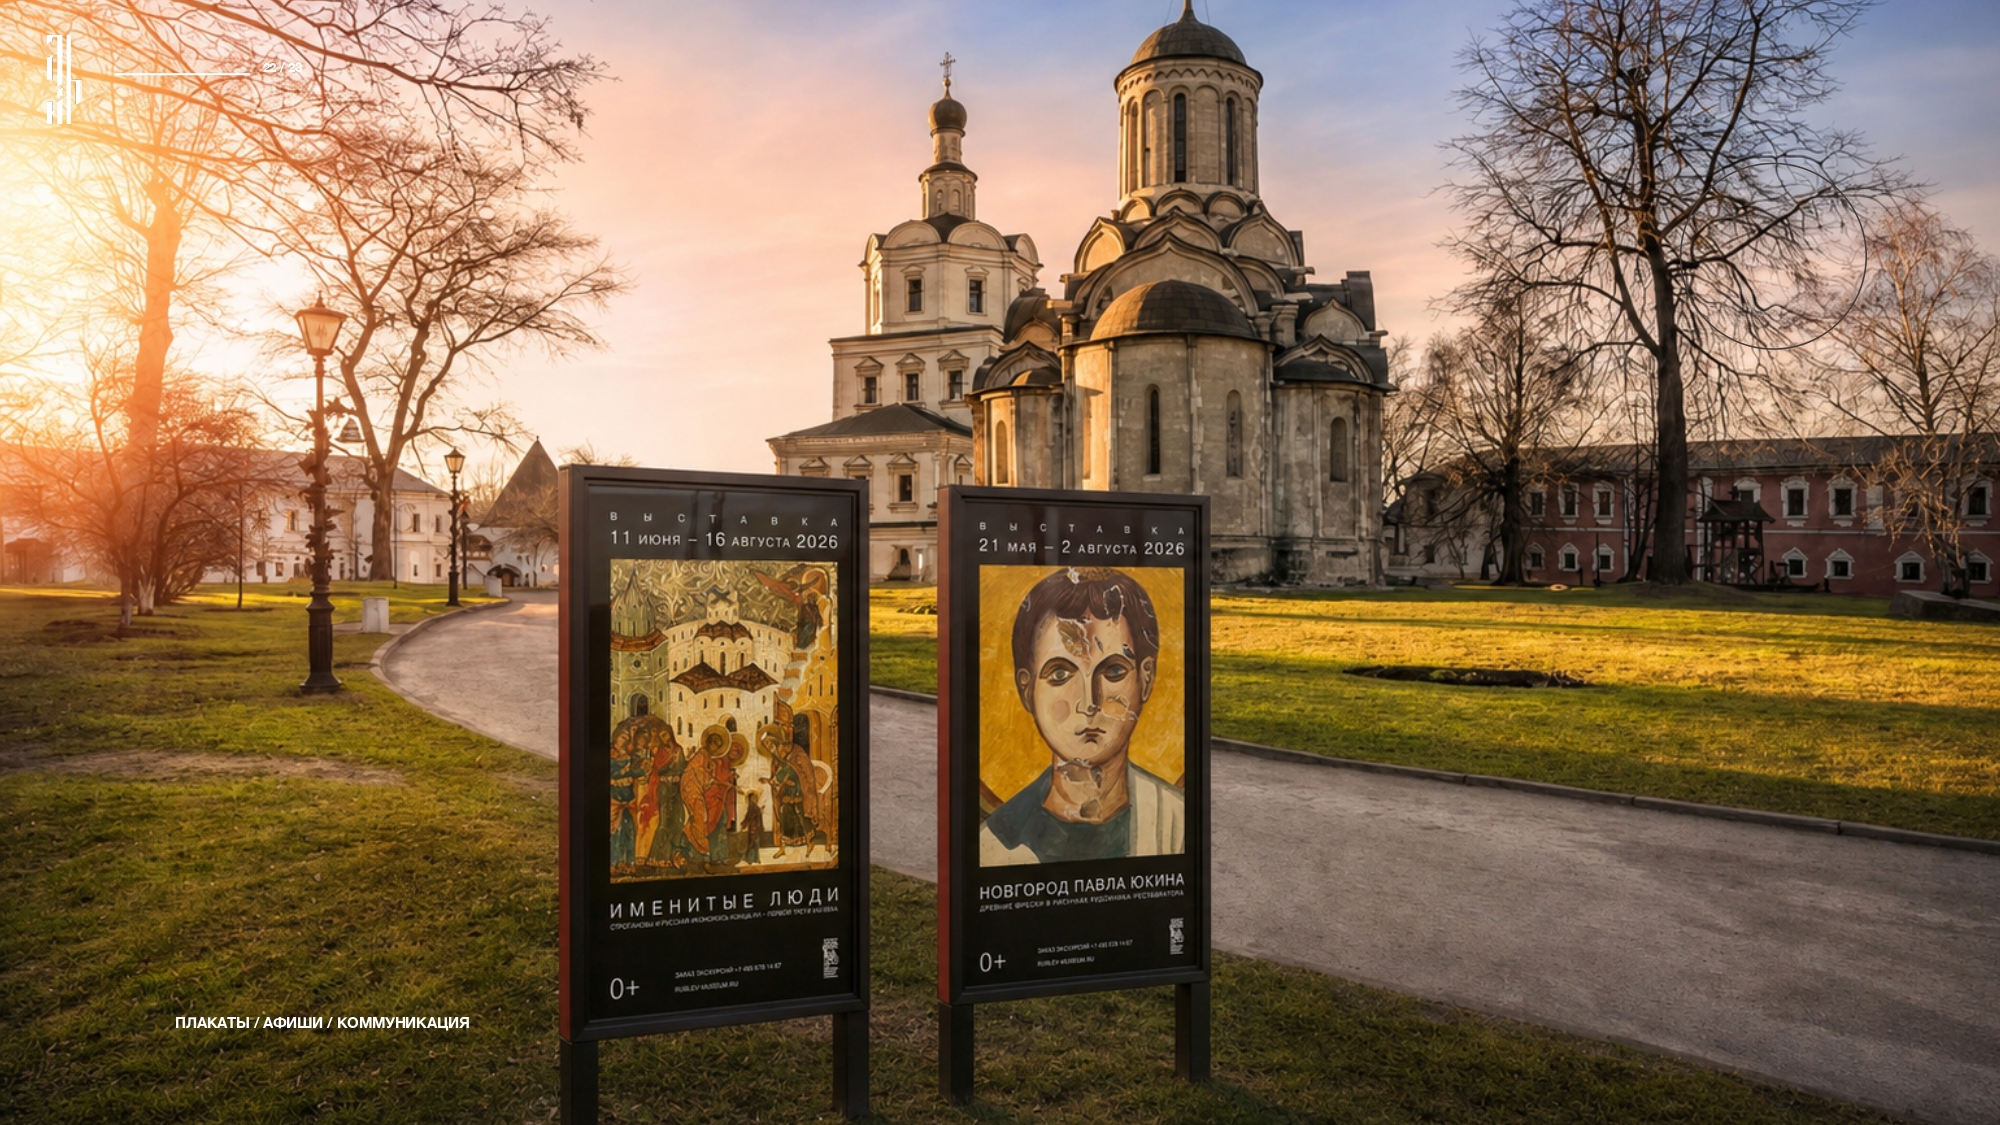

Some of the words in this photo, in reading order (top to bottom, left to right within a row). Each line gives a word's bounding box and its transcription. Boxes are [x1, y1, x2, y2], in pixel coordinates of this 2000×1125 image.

[611, 530, 630, 545] 11
[638, 534, 681, 546] ИЮНЯ
[705, 532, 726, 547] 16
[731, 537, 791, 548] АВГУСТА
[796, 534, 838, 549] 2026
[979, 538, 998, 552] 21
[1007, 542, 1037, 553] МАЯ
[1061, 540, 1071, 554] 2
[1077, 544, 1138, 555] АВГУСТА
[1144, 541, 1185, 556] 2026
[979, 880, 1069, 900] НОВГОРОД
[1074, 877, 1126, 893] ПАВЛА
[1131, 873, 1185, 889] ЮКИНА
[610, 893, 754, 919] ИМЕНИТЫЕ
[769, 887, 839, 907] ЛЮДИ
[979, 952, 1007, 973] 0+
[610, 978, 640, 1000] 0+
